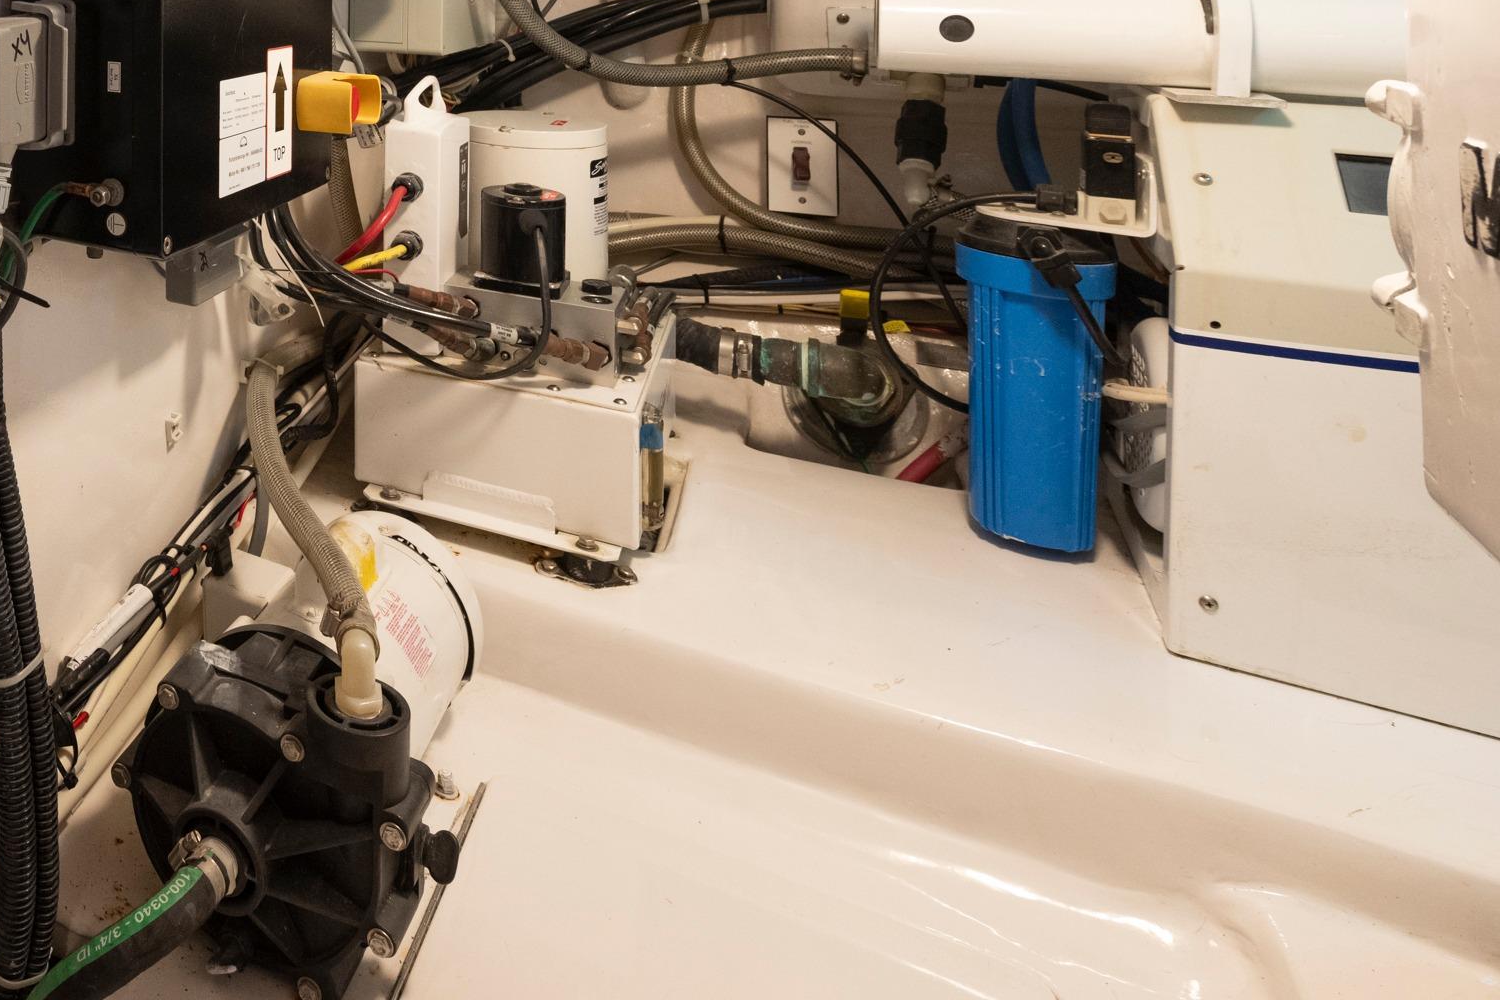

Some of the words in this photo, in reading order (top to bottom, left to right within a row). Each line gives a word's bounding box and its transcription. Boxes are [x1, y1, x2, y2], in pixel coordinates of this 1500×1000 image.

[272, 145, 287, 162] TOP
[134, 872, 191, 924] 100-0340
[95, 926, 122, 952] 3/4"
[76, 944, 91, 962] ID
